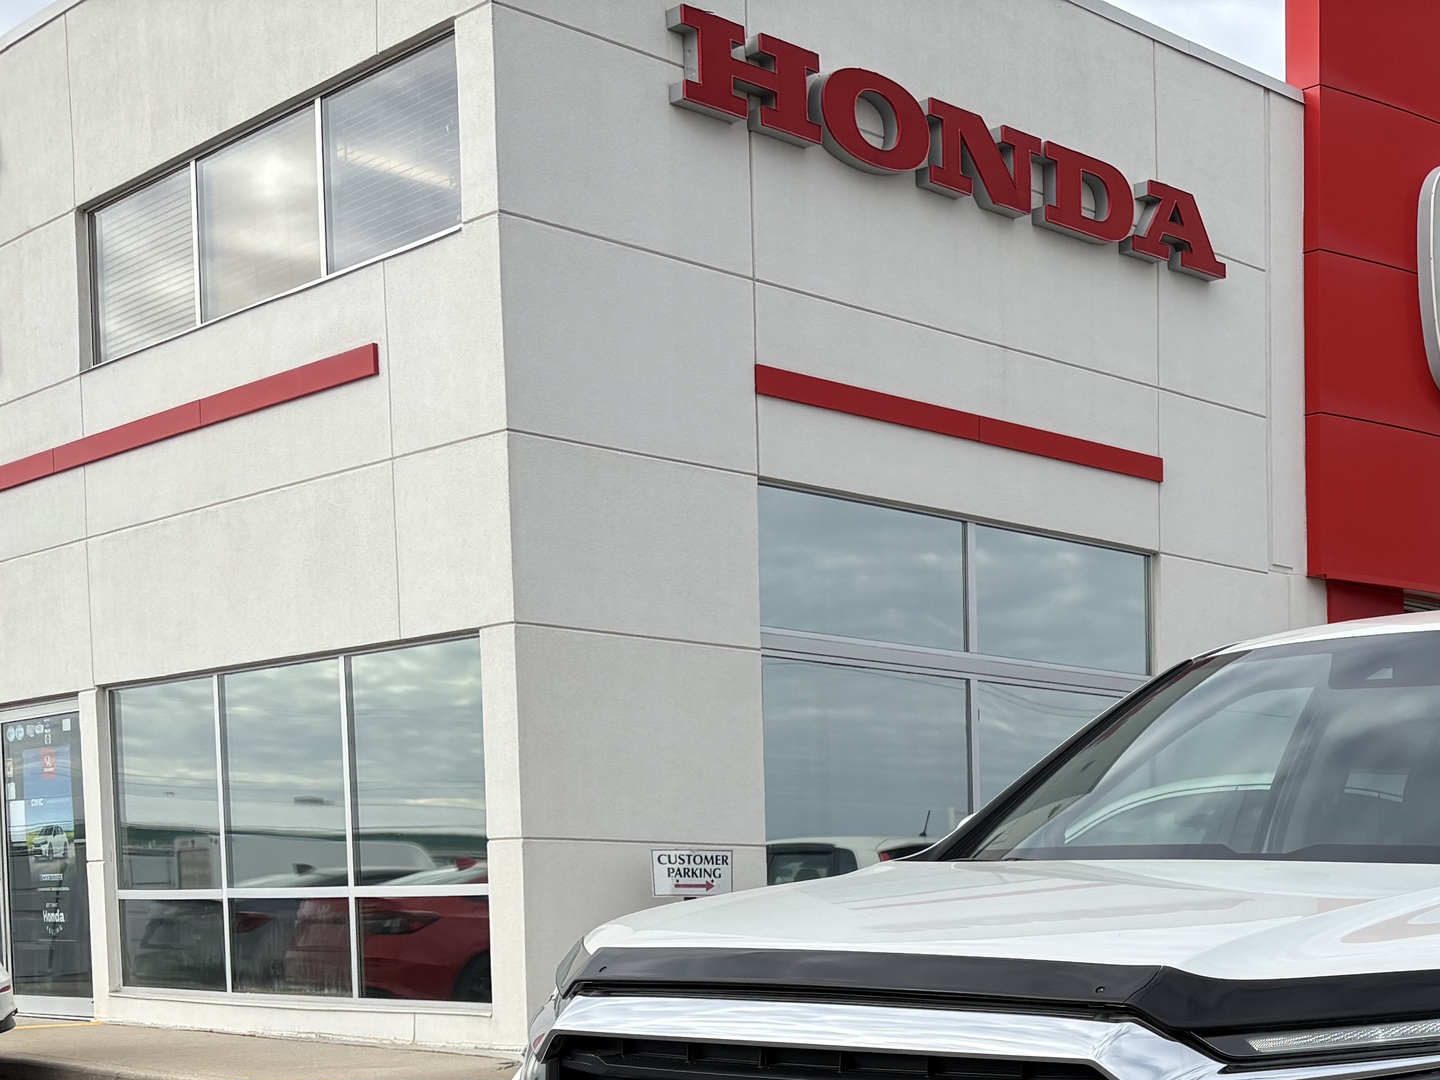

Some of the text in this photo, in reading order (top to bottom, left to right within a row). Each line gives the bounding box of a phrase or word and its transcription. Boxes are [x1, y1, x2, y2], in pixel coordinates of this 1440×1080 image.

[667, 3, 1226, 281] HONDA
[657, 853, 729, 866] CUSTOMER
[667, 867, 722, 879] PARKING
[42, 908, 66, 923] Honda
